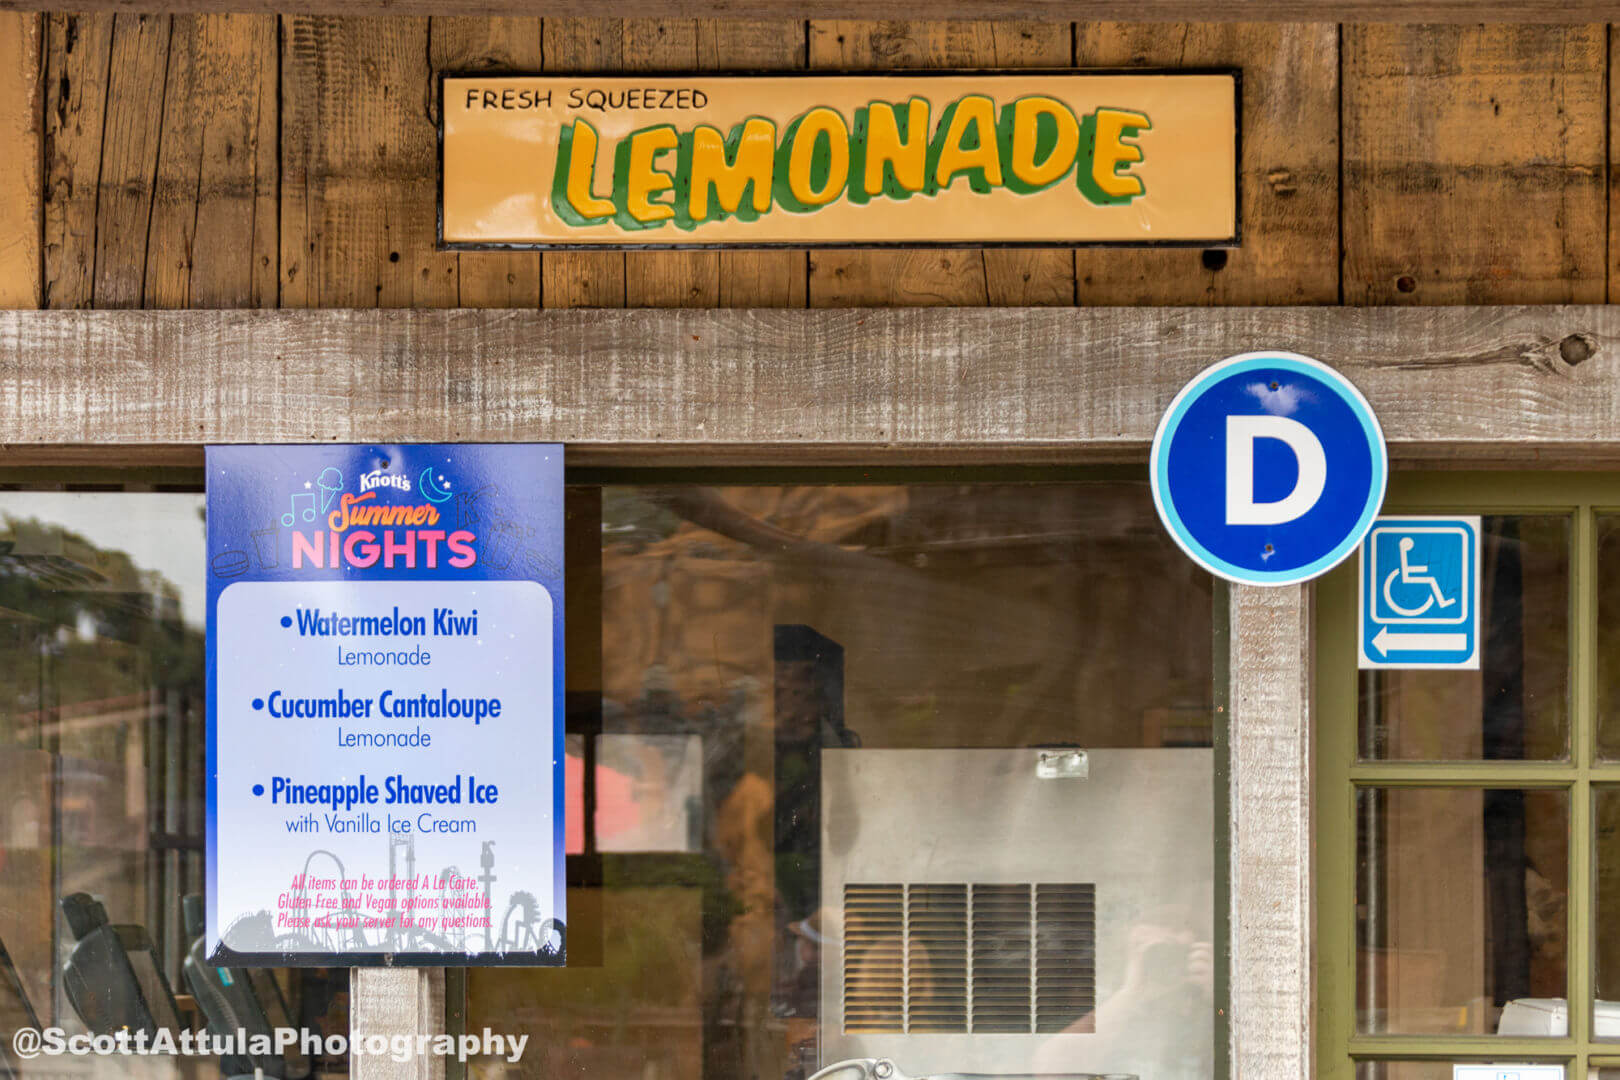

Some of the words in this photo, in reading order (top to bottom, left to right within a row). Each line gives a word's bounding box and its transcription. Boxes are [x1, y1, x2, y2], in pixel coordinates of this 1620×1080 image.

[465, 89, 552, 109] FRESH
[567, 88, 708, 112] SQUEEZED
[551, 95, 1152, 231] LEMONADE
[360, 470, 411, 492] Knott's
[1225, 415, 1327, 525] D
[328, 491, 440, 532] Summer
[292, 530, 478, 569] NIGHTS
[296, 606, 427, 636] Watermelon
[433, 608, 478, 636] Kiwi
[338, 644, 431, 665] Lemonade
[268, 688, 373, 719] Cucumber
[379, 688, 501, 725] Cantaloupe
[338, 726, 431, 747] Lemonade
[272, 774, 379, 811] Pineapple
[385, 774, 462, 805] Shaved
[468, 776, 498, 804] Ice
[285, 812, 319, 833] with
[325, 812, 381, 833] Vanilla
[387, 813, 411, 833] Ice
[417, 813, 477, 833] Cream
[291, 873, 306, 890] All
[308, 875, 336, 890] items
[340, 879, 358, 890] can
[361, 874, 374, 890] be
[377, 874, 420, 890] ordered
[422, 875, 430, 890] A
[433, 875, 446, 890] La
[449, 874, 479, 890] Carte.
[278, 893, 312, 909] Gluten
[315, 893, 338, 909] Free
[342, 892, 362, 909] and
[365, 894, 396, 913] Vegan
[400, 894, 439, 914] options
[442, 892, 493, 909] available.
[277, 912, 310, 928] Please
[314, 912, 332, 928] ask
[336, 916, 360, 931] your
[363, 916, 396, 928] server
[399, 911, 415, 928] for
[418, 916, 438, 931] any
[441, 913, 493, 931] questions.
